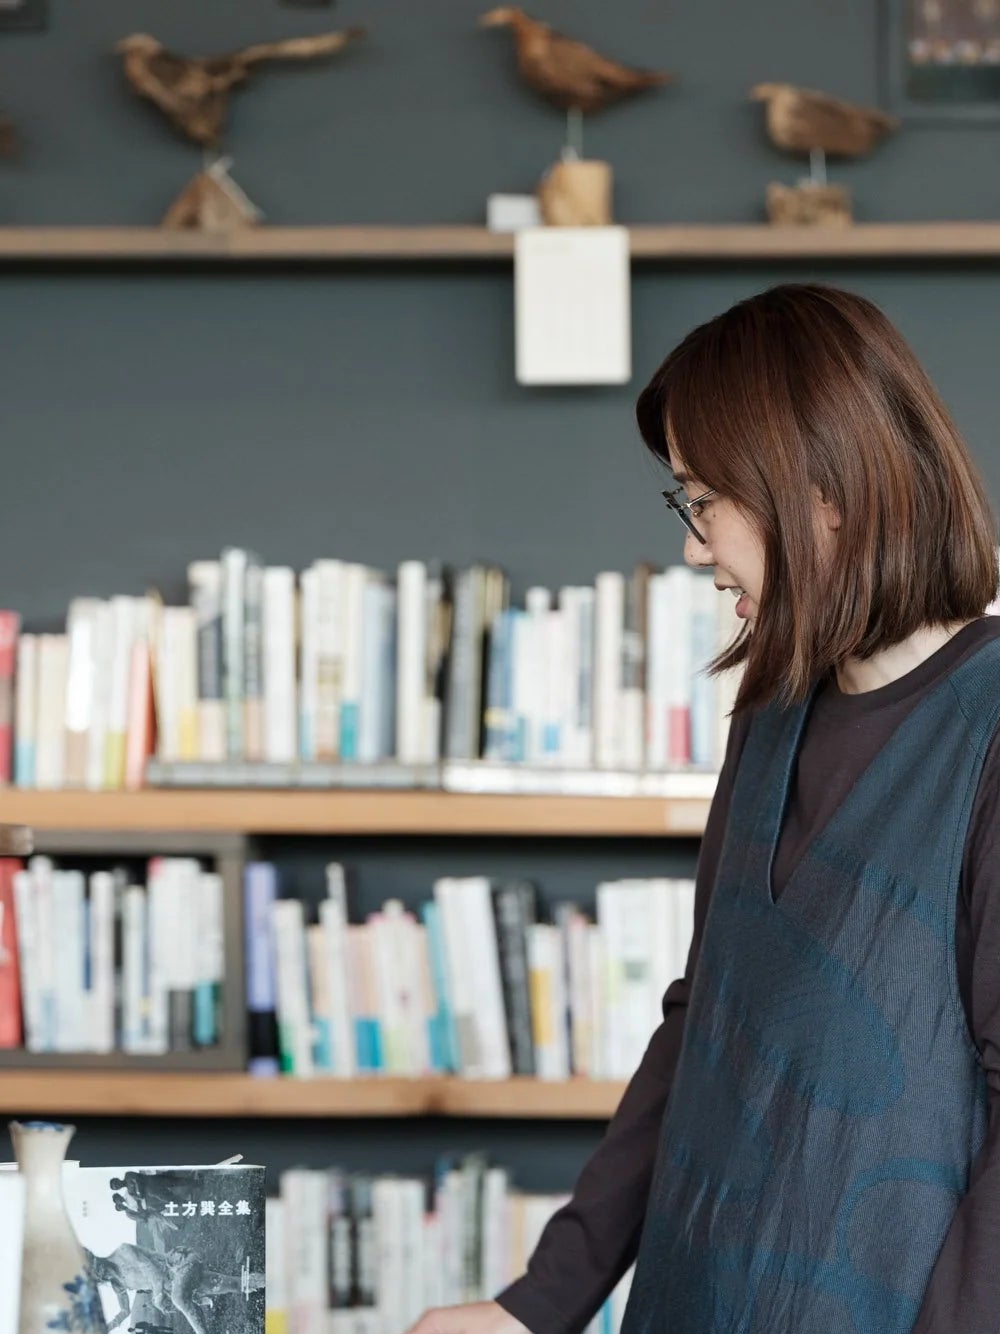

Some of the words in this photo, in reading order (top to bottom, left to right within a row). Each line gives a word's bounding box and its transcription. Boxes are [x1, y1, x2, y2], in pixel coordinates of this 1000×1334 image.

[163, 1200, 251, 1217] 土方巽全集
